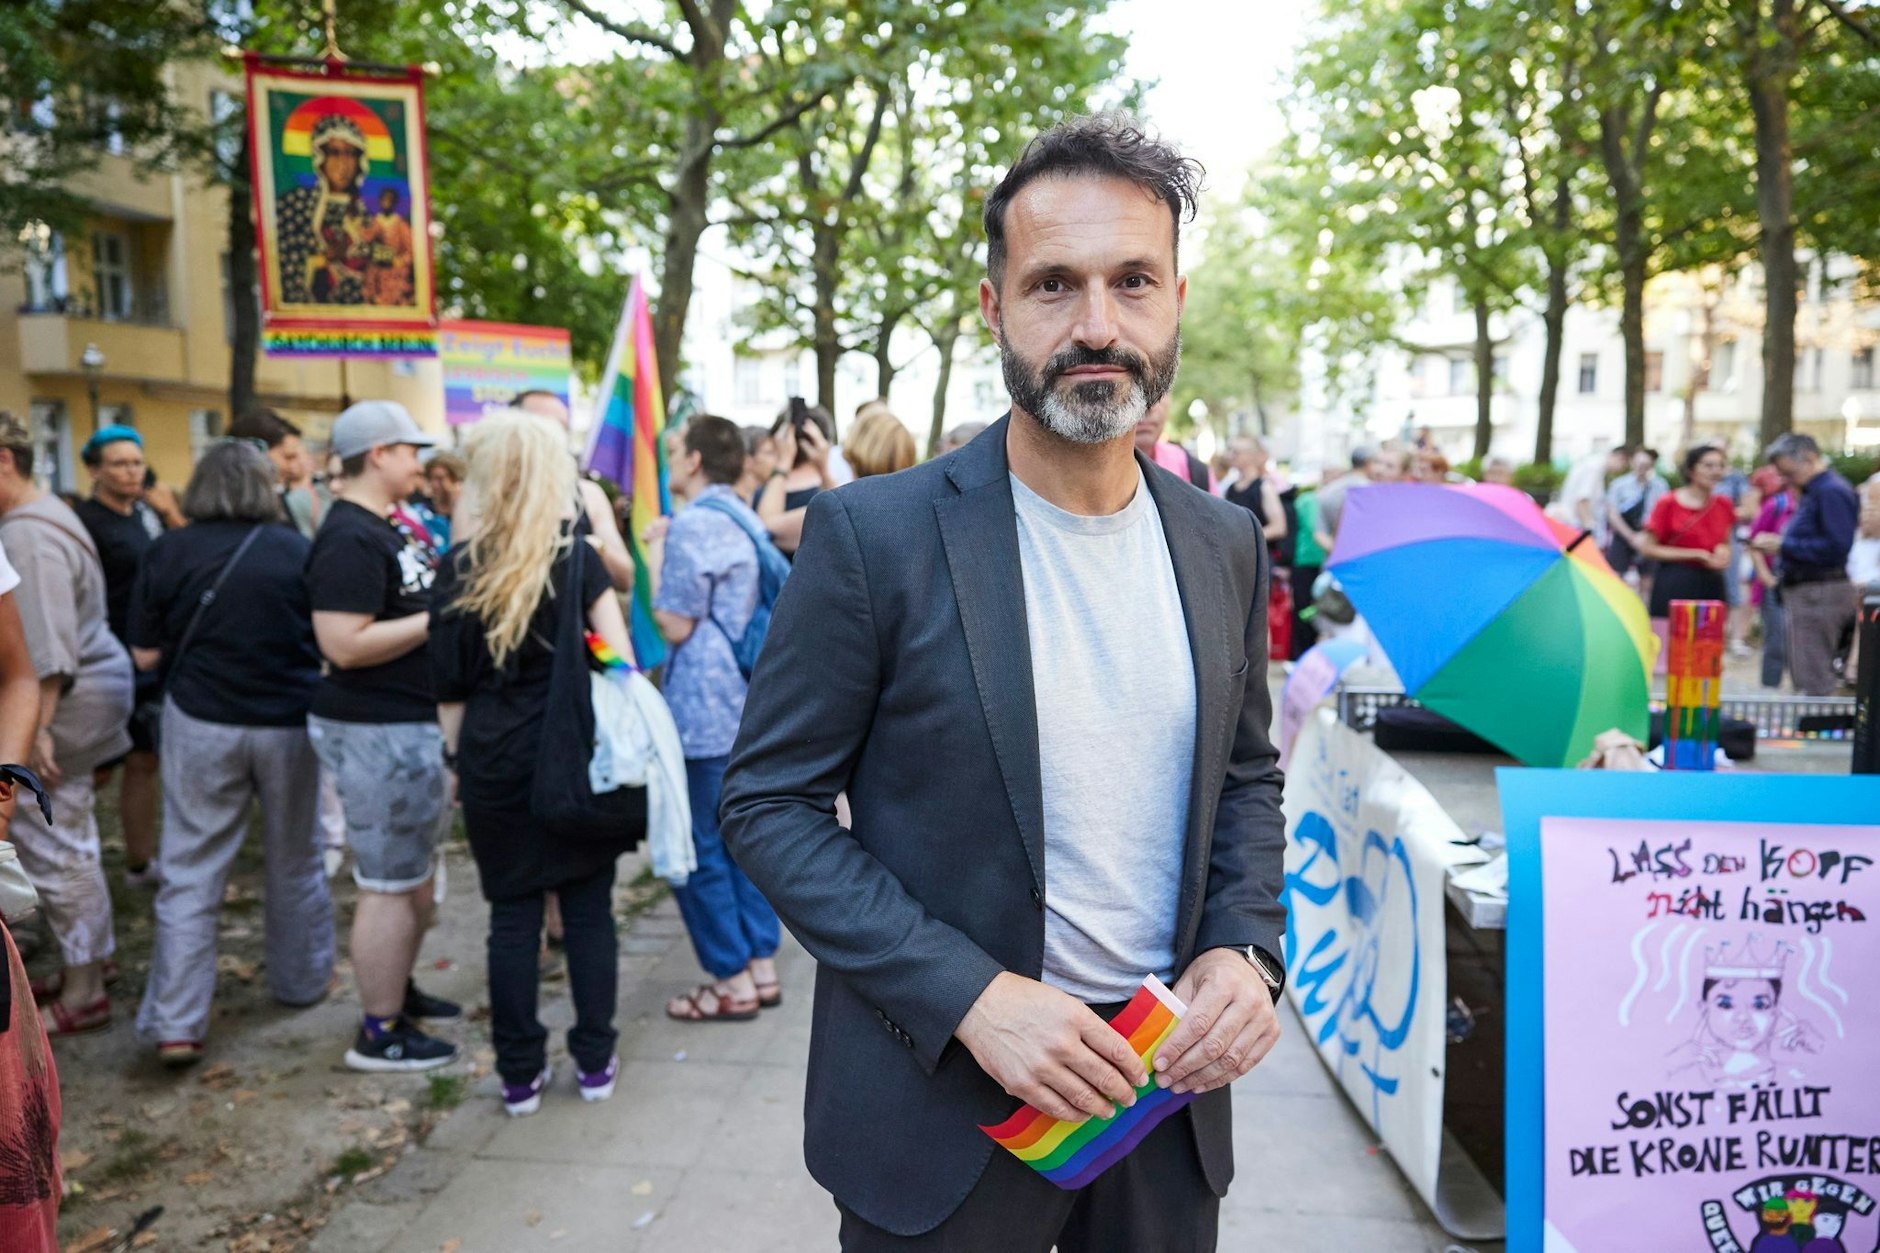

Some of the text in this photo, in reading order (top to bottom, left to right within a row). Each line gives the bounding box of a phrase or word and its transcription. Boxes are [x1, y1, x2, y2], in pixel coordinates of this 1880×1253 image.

[1608, 839, 1874, 884] LASS DEN KOPF
[1647, 886, 1866, 934] nicht hängen
[1611, 1082, 1831, 1130] SONST FÄLLT
[1569, 1146, 1621, 1176] DIE
[1629, 1137, 1747, 1177] KRONE
[1735, 1176, 1873, 1214] WIR GEGEN
